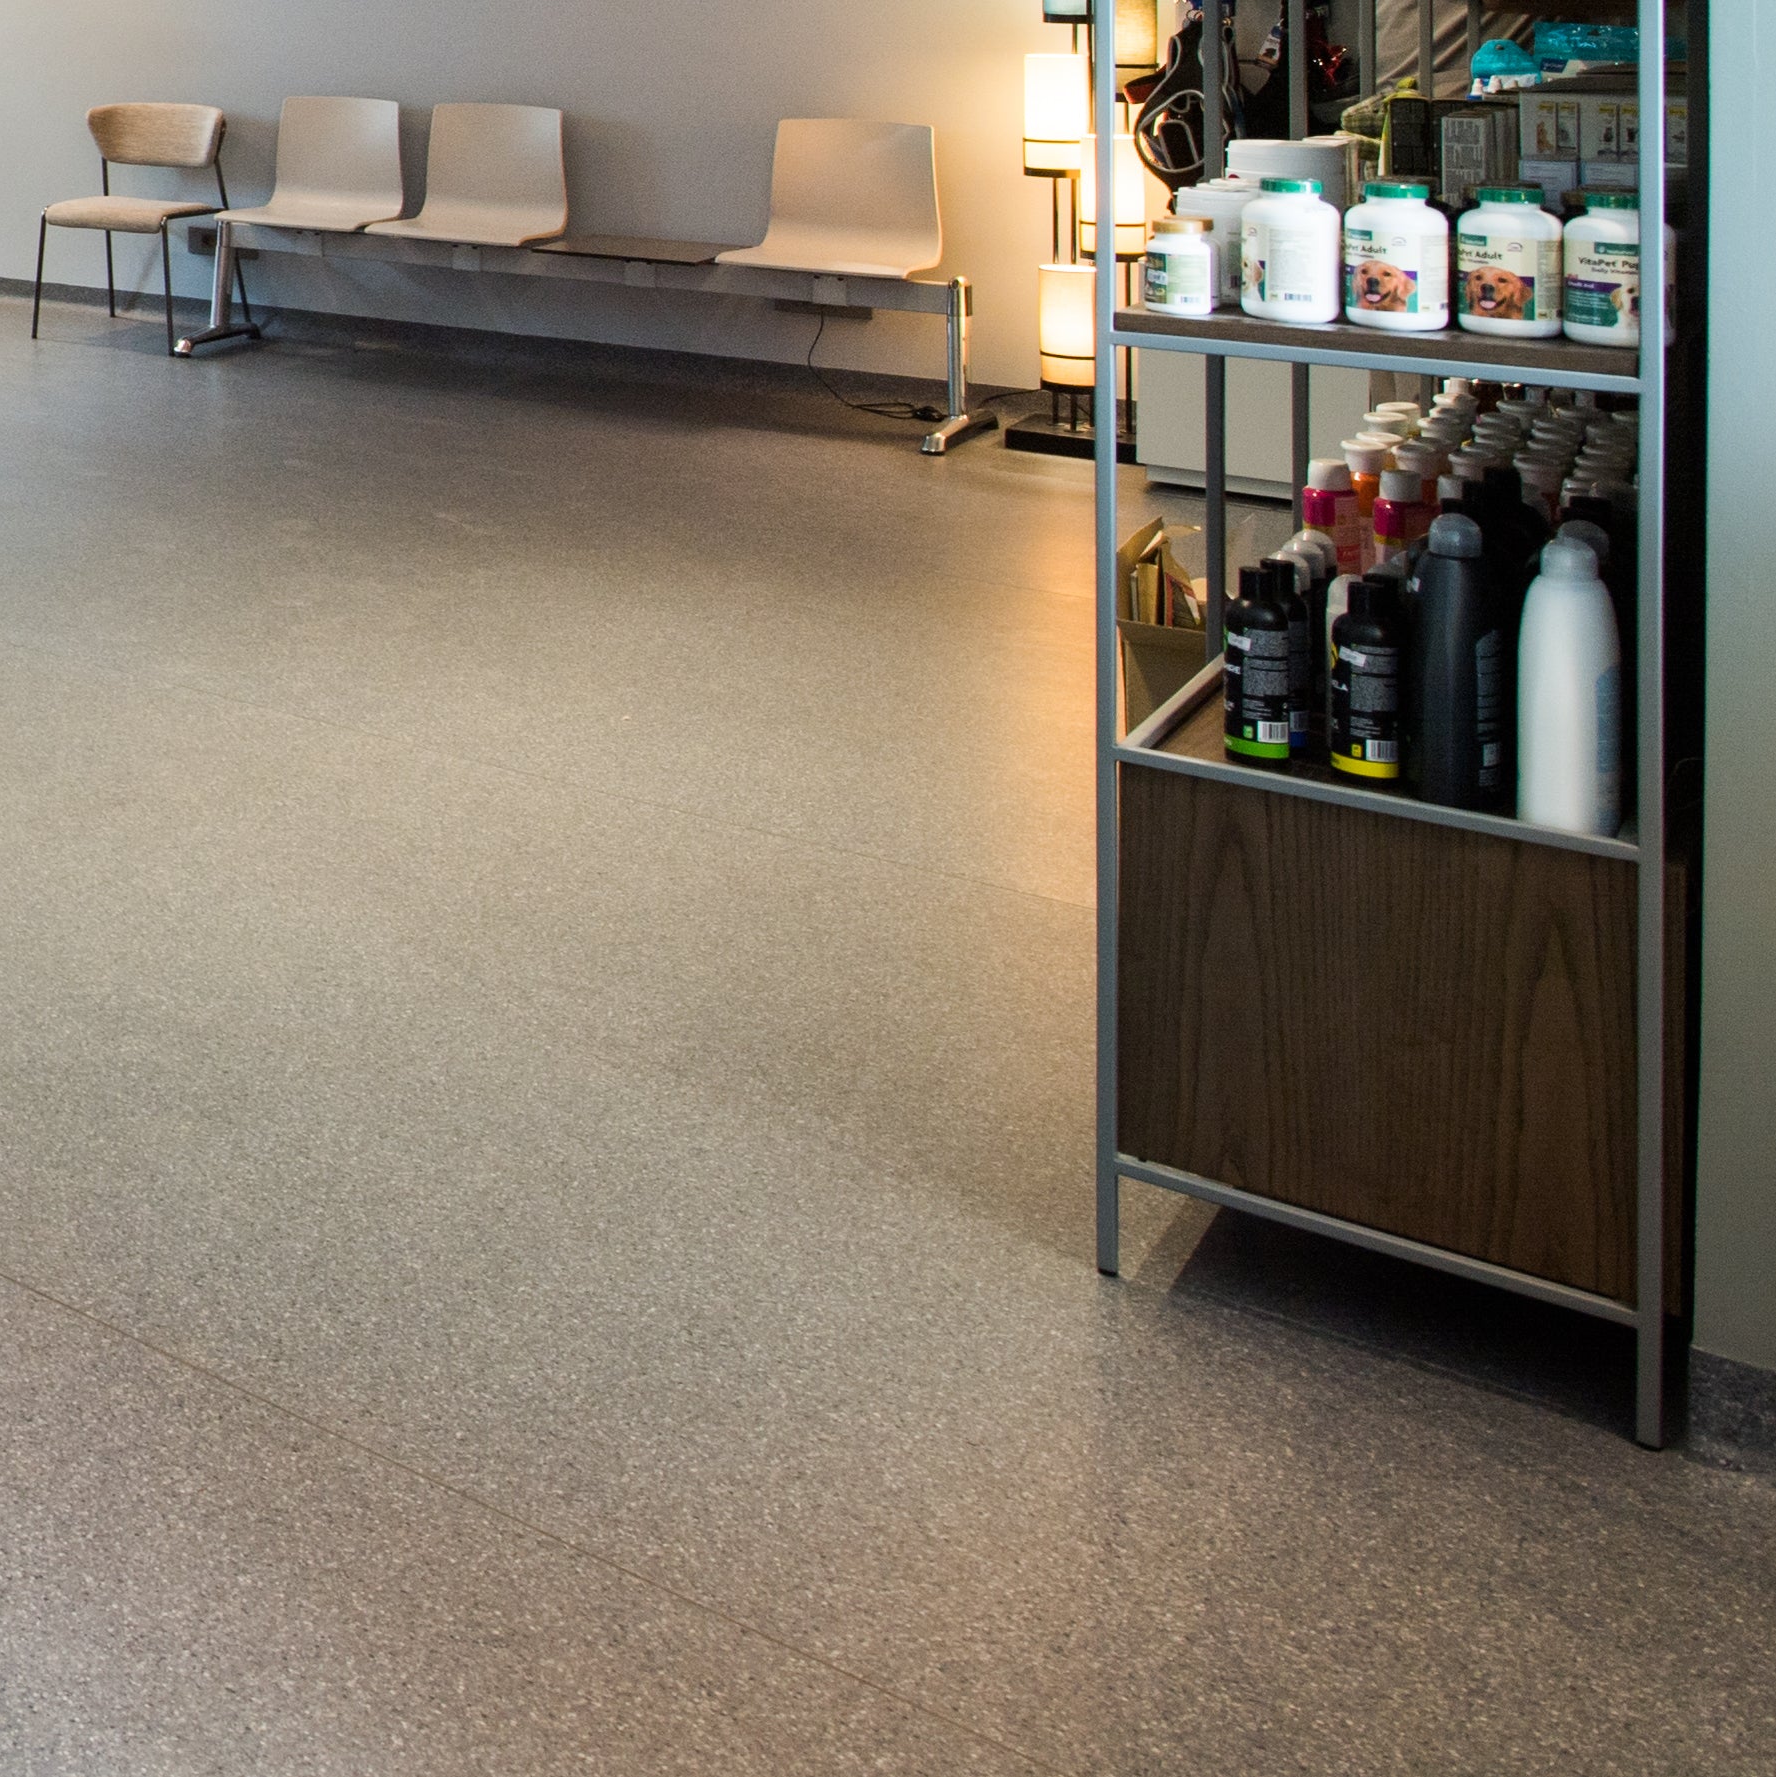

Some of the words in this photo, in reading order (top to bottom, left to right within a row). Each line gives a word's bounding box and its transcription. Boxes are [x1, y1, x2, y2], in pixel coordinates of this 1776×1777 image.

[1360, 245, 1387, 255] Adult
[1474, 250, 1503, 260] Adult
[1578, 256, 1617, 267] VitaPet
